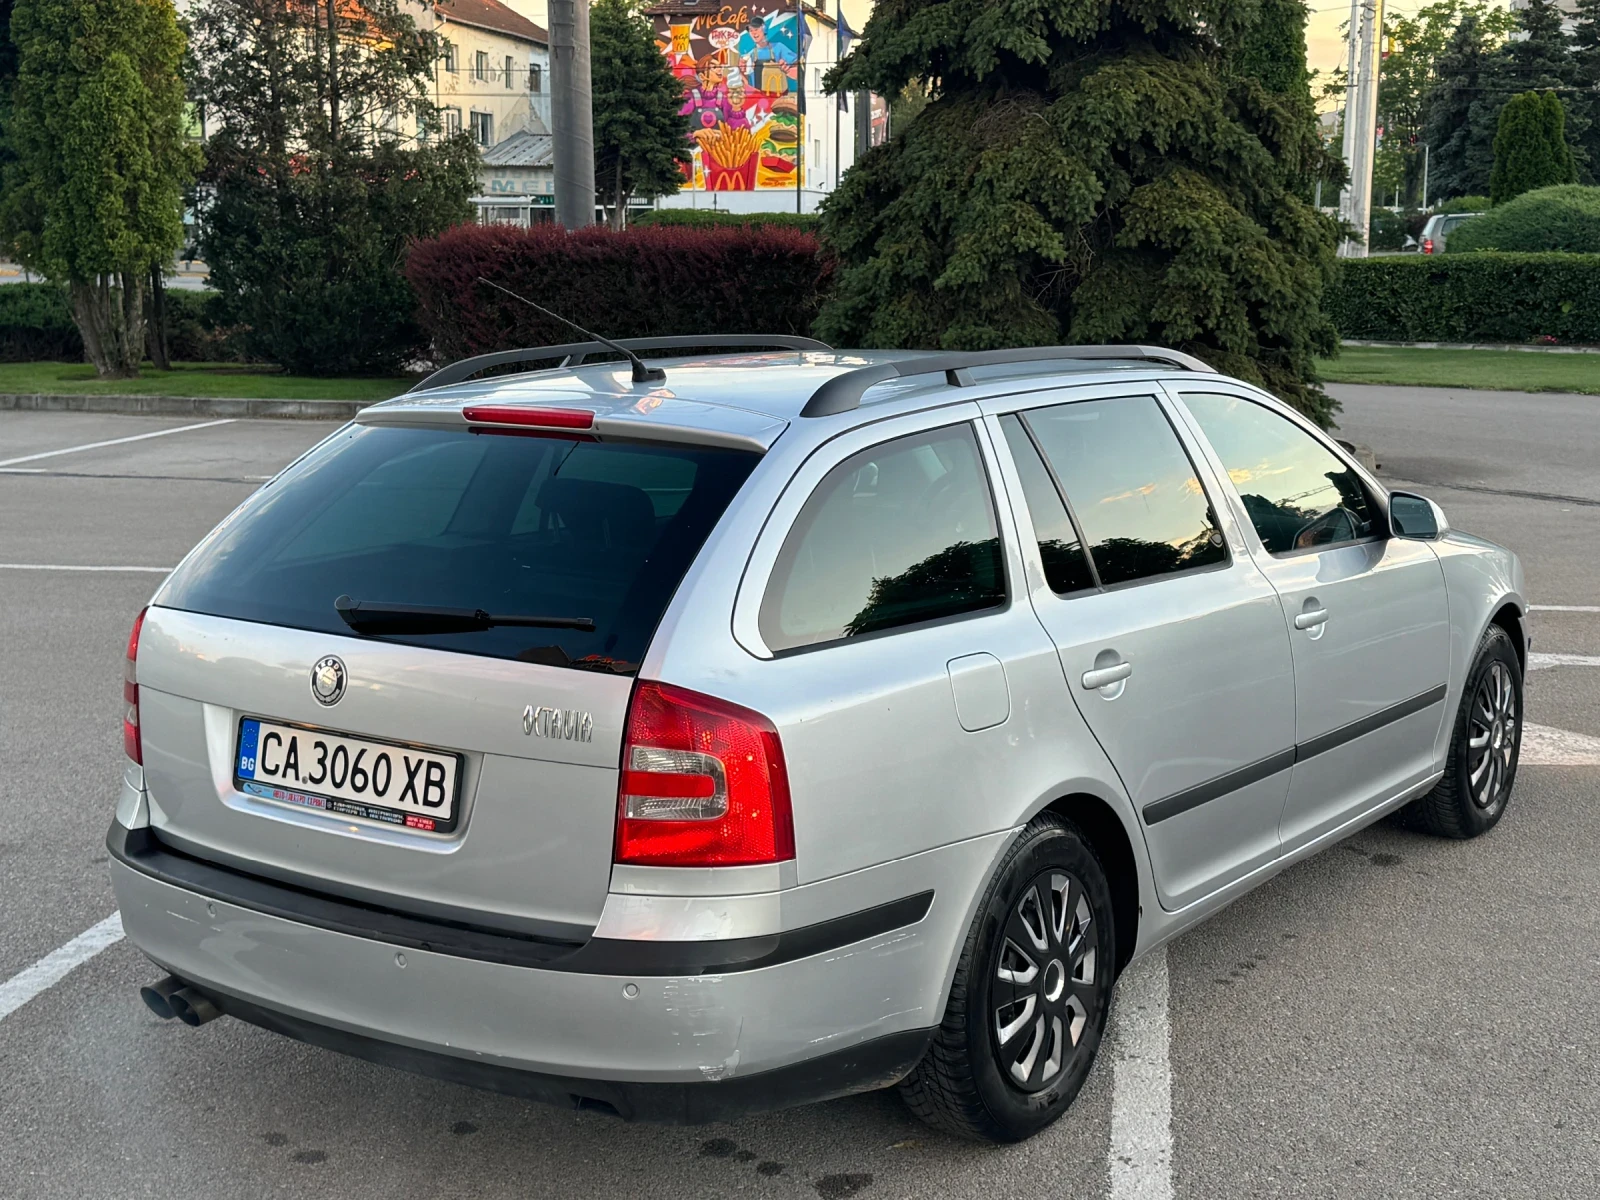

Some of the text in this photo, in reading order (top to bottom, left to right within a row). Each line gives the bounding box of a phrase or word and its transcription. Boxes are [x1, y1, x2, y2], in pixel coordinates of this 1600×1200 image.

[523, 705, 593, 743] OCTAVIA
[241, 756, 255, 771] BG
[398, 755, 446, 808] XB
